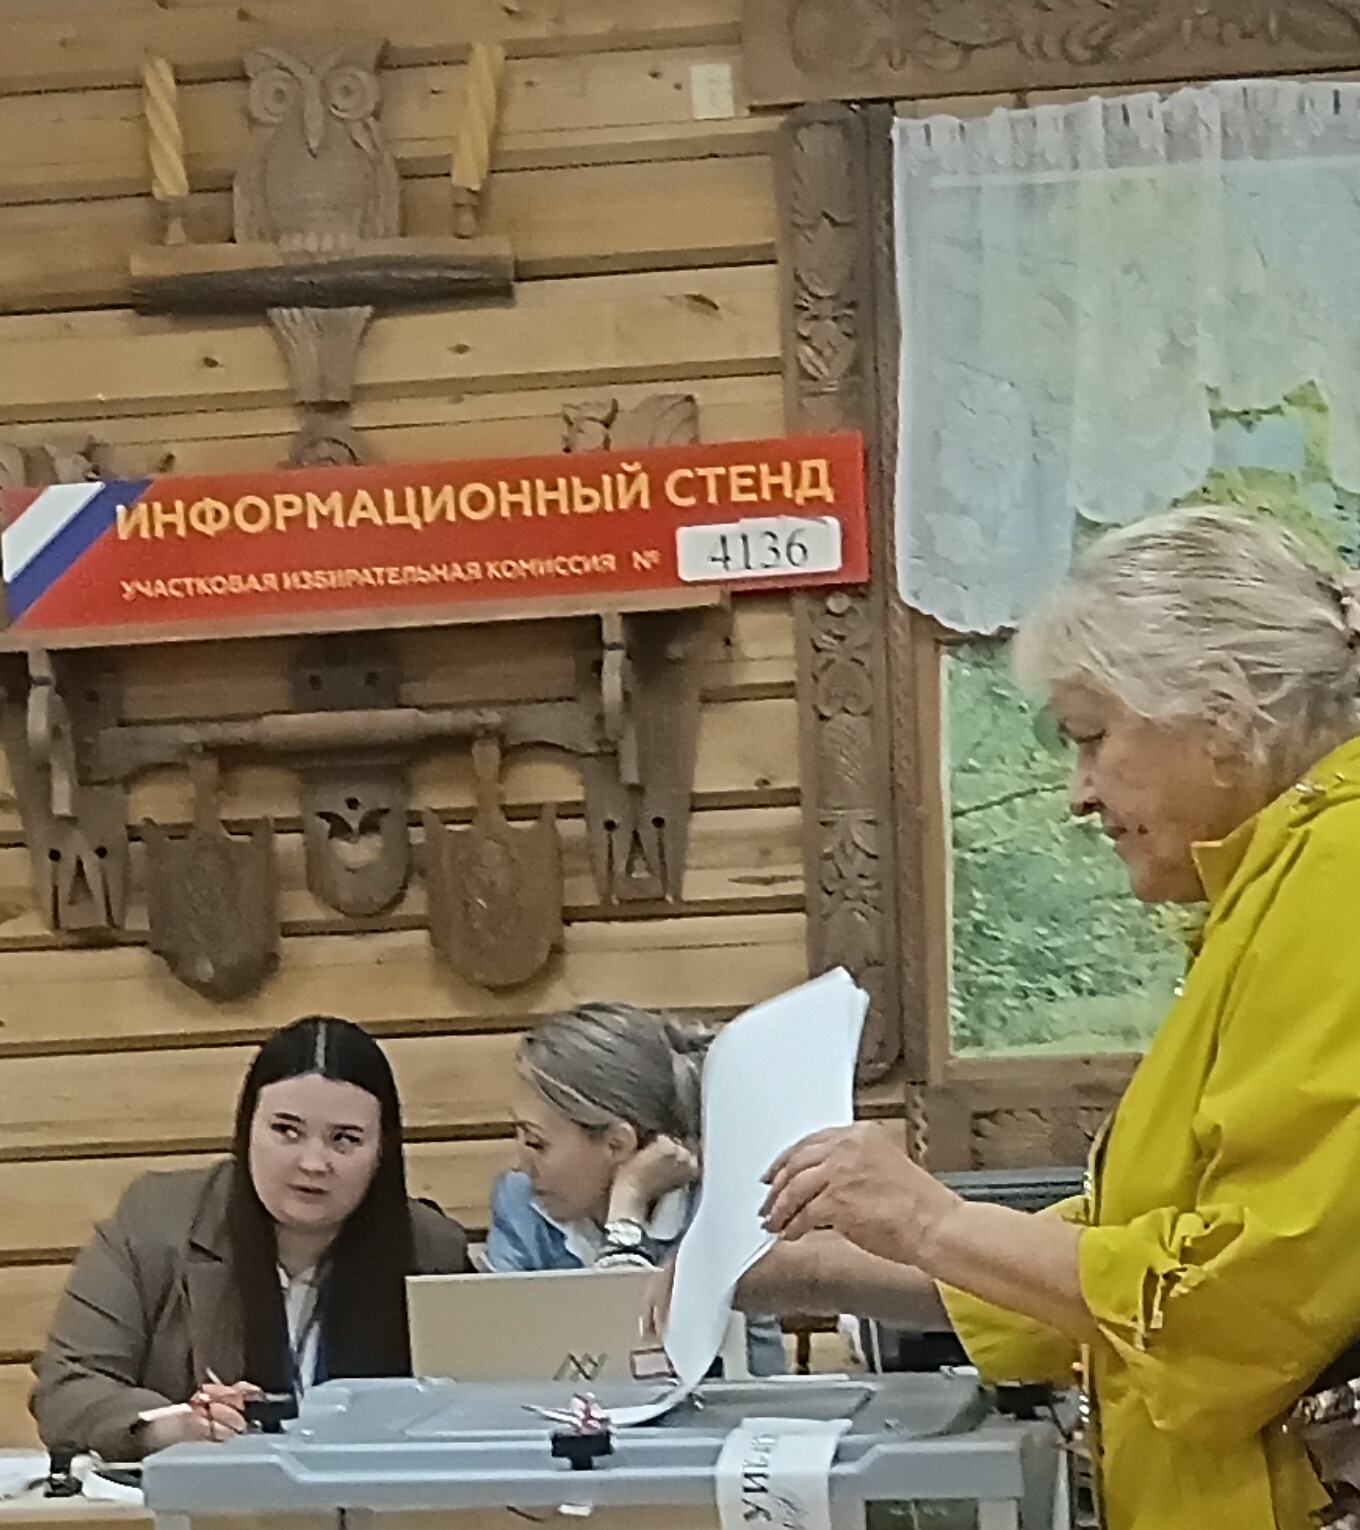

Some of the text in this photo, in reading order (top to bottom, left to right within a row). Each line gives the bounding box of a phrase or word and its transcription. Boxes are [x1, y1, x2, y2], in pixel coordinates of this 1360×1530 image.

[115, 458, 834, 541] ИНФОРМАЦИОННЫЙ СТЕНД
[120, 572, 280, 601] УЧАСТКОВАЯ
[282, 557, 482, 592] ИЗБИРАТЕЛЬНАЯ
[486, 551, 617, 581] КОМИССИЯ
[707, 527, 809, 573] 4136
